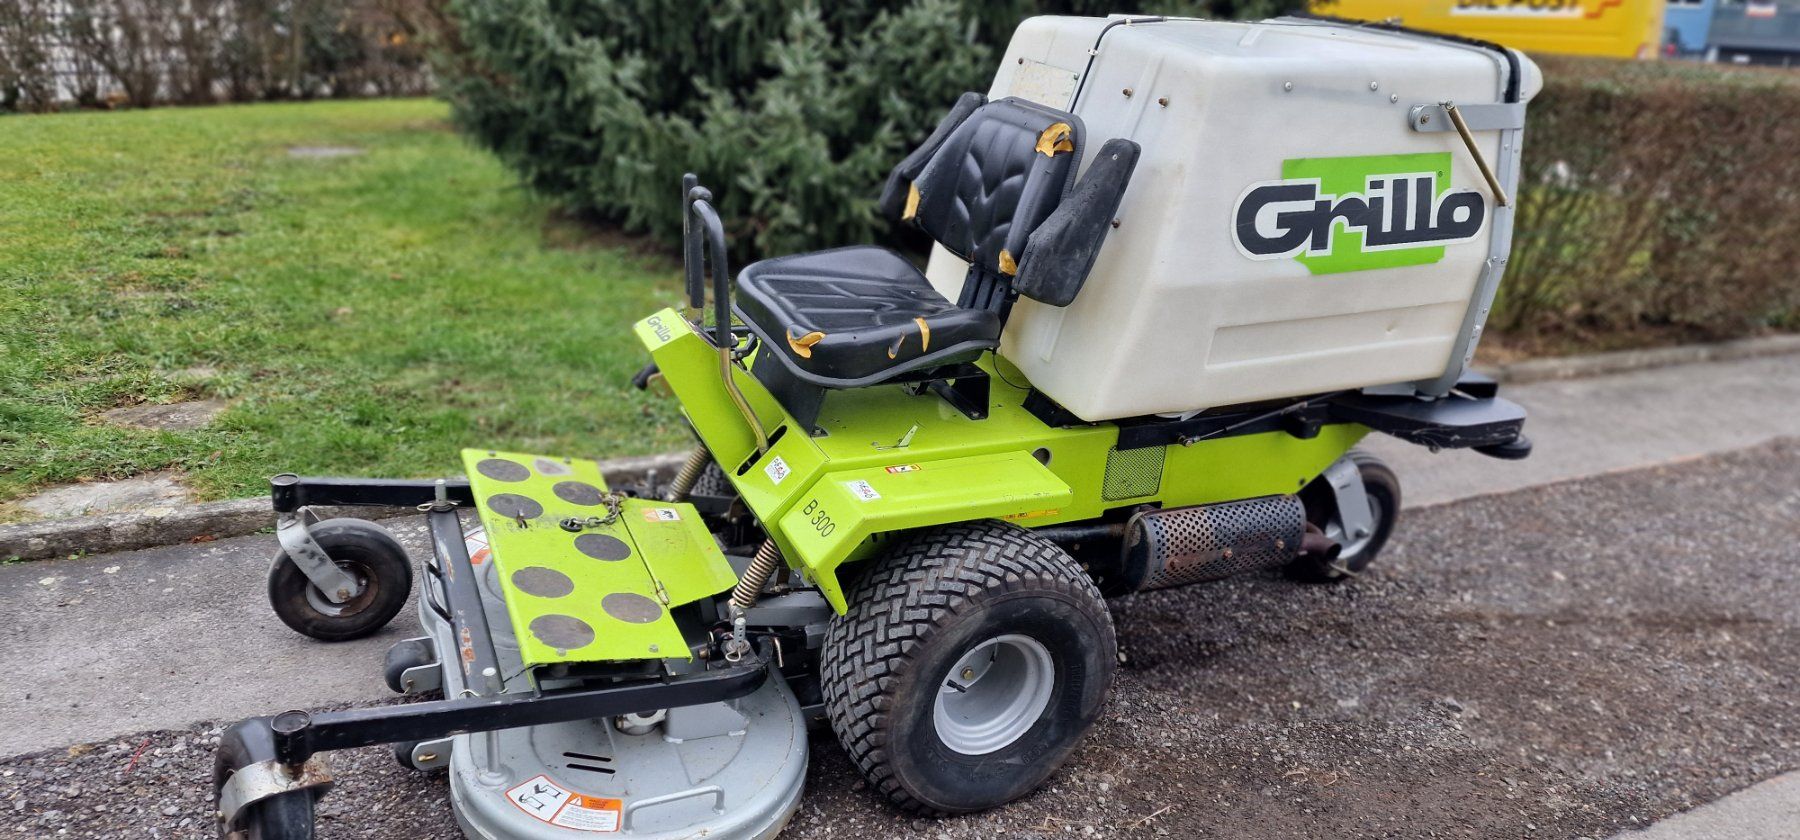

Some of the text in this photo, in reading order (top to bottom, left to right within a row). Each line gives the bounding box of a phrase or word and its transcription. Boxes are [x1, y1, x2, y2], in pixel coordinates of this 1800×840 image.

[1236, 177, 1485, 255] Grillo
[647, 316, 672, 342] Grillo
[803, 499, 836, 537] B 300
